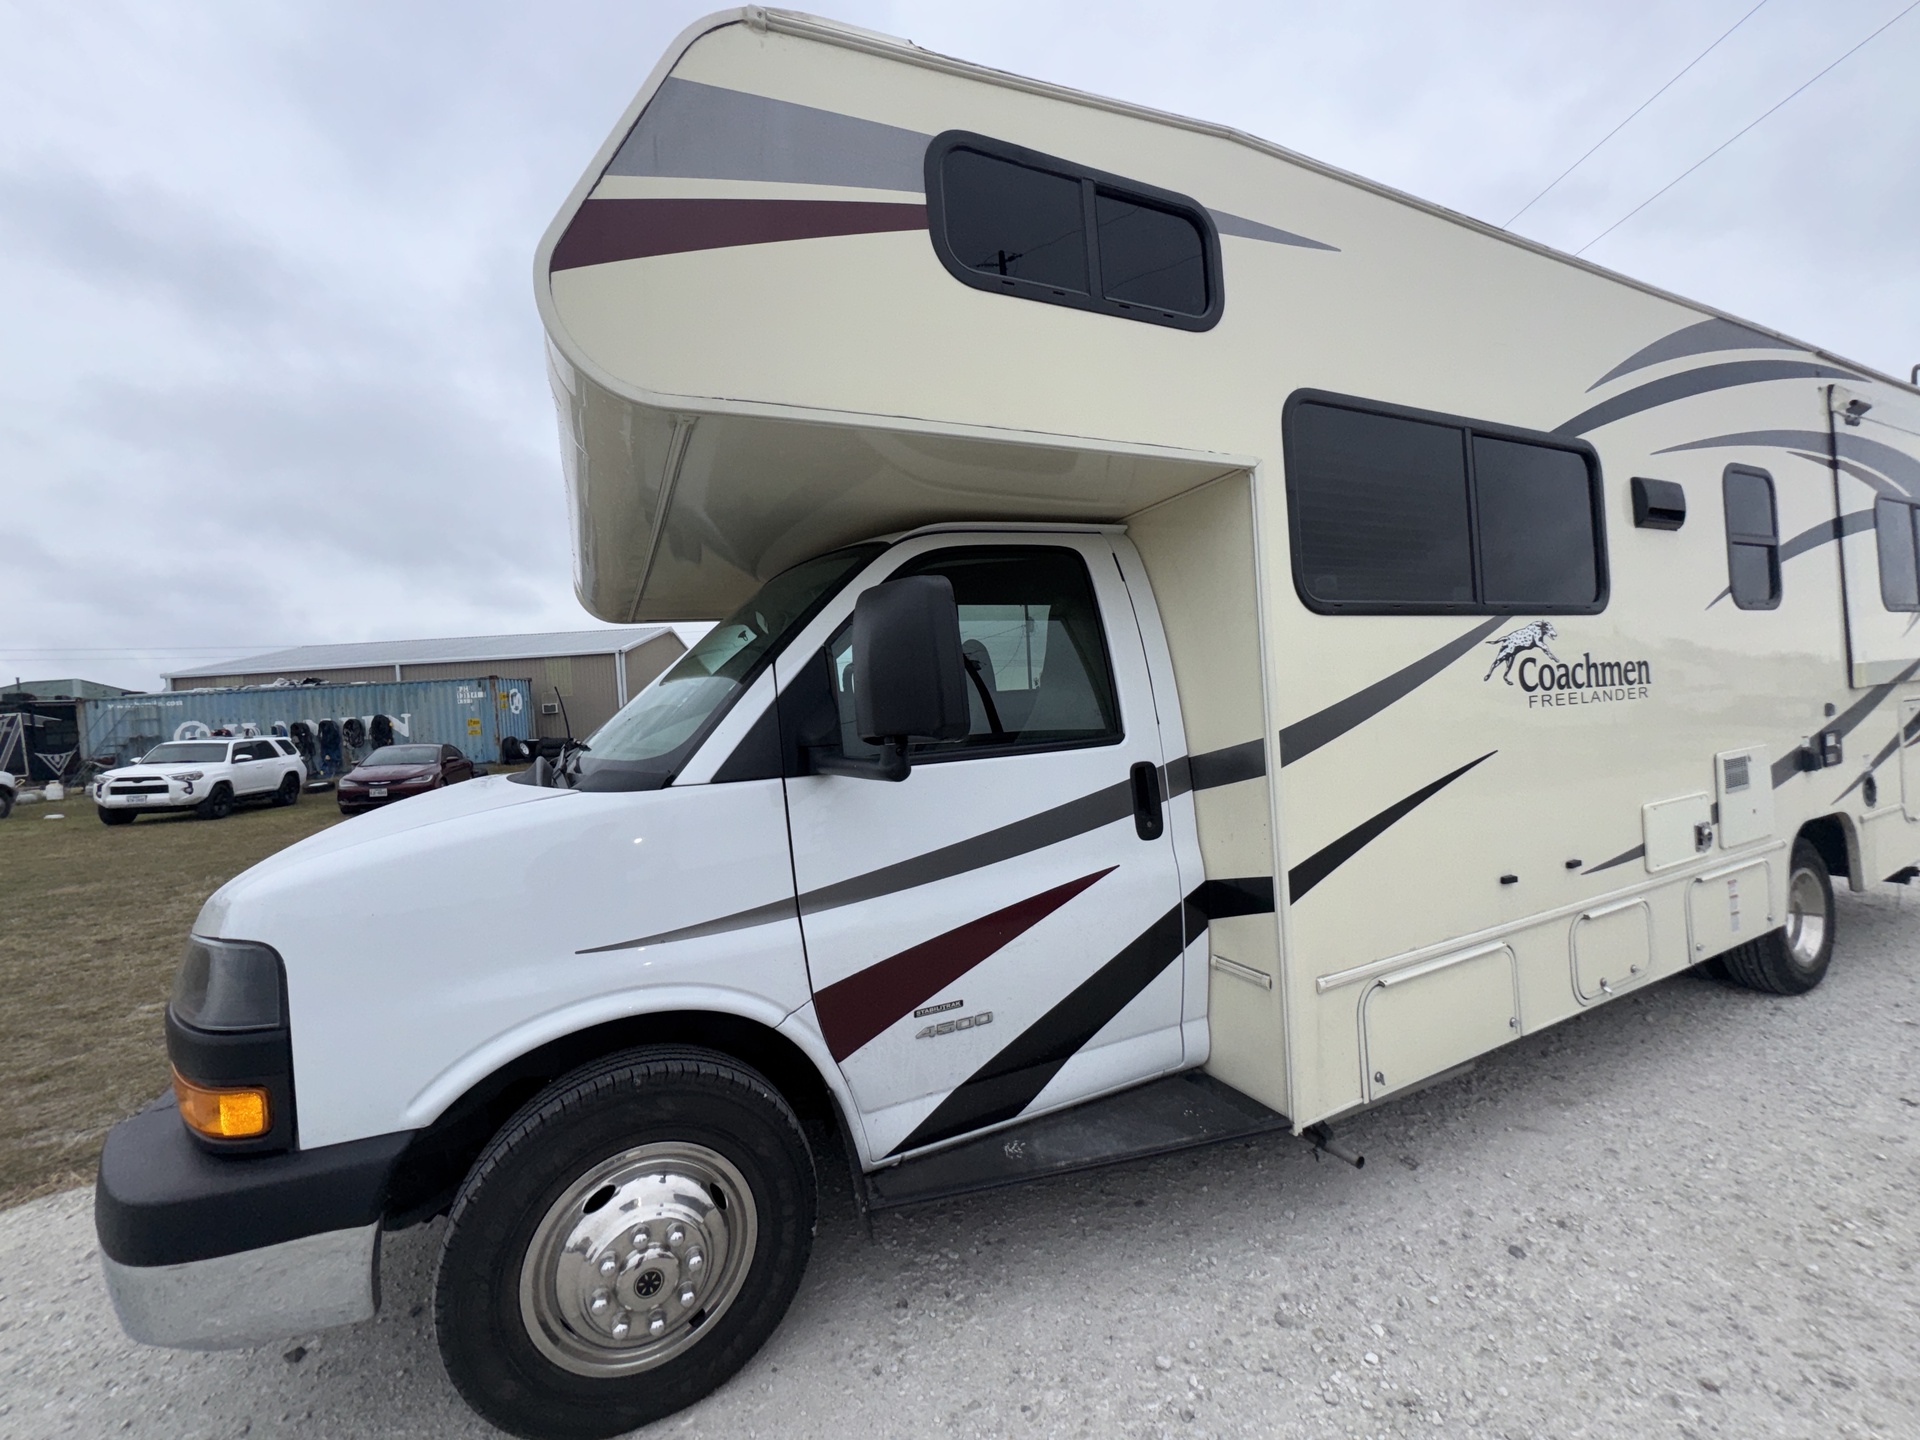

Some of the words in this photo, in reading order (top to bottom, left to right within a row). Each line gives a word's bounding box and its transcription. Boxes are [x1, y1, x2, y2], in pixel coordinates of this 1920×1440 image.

[1518, 652, 1652, 692] Coachmen
[1528, 687, 1649, 709] FREELANDER
[915, 1000, 963, 1017] STABILITRAK
[915, 1011, 994, 1040] 4500
